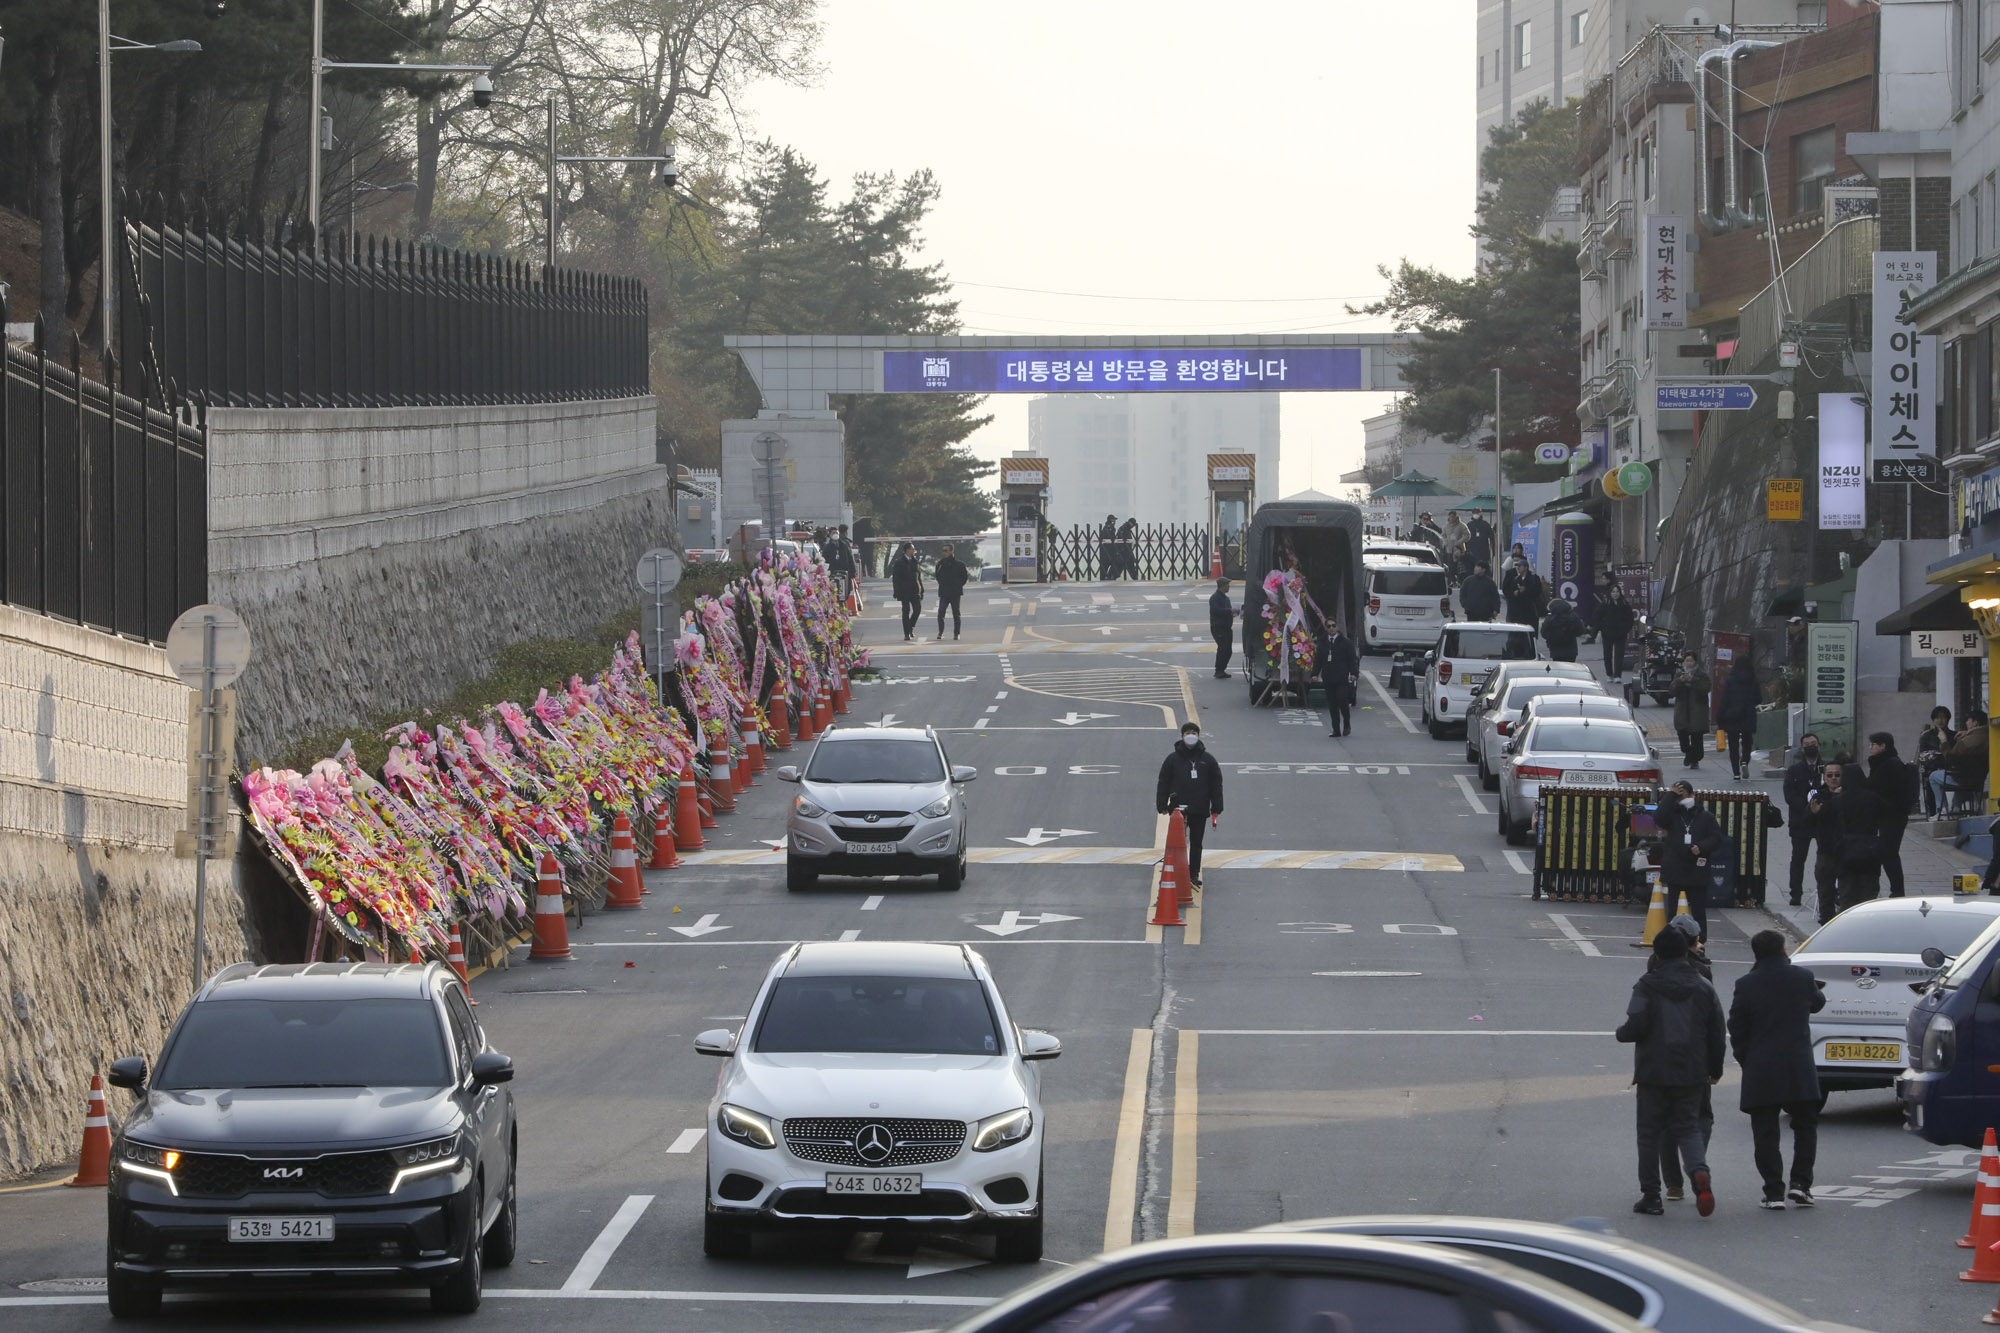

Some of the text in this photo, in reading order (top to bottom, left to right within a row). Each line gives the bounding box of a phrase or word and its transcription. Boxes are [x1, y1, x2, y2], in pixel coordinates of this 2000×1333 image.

[1656, 225, 1677, 303] 현대本家
[1885, 272, 1924, 282] 체스교육
[1007, 358, 1288, 382] 대통령실 방문을 환영합니다
[1699, 401, 1723, 409] 4ga-gil
[1543, 449, 1563, 459] CU
[1823, 466, 1860, 476] NZ4U
[1881, 465, 1928, 477] 용산 본점
[1823, 478, 1860, 488] 엔젯포유
[1564, 538, 1572, 572] Nice to
[1817, 653, 1845, 661] 건강식품
[1277, 922, 1458, 935] 30
[1838, 1046, 1861, 1057] 31사
[1863, 1047, 1895, 1059] 8226
[835, 1177, 912, 1192] 64조 0632
[239, 1221, 322, 1237] 53합 5421
